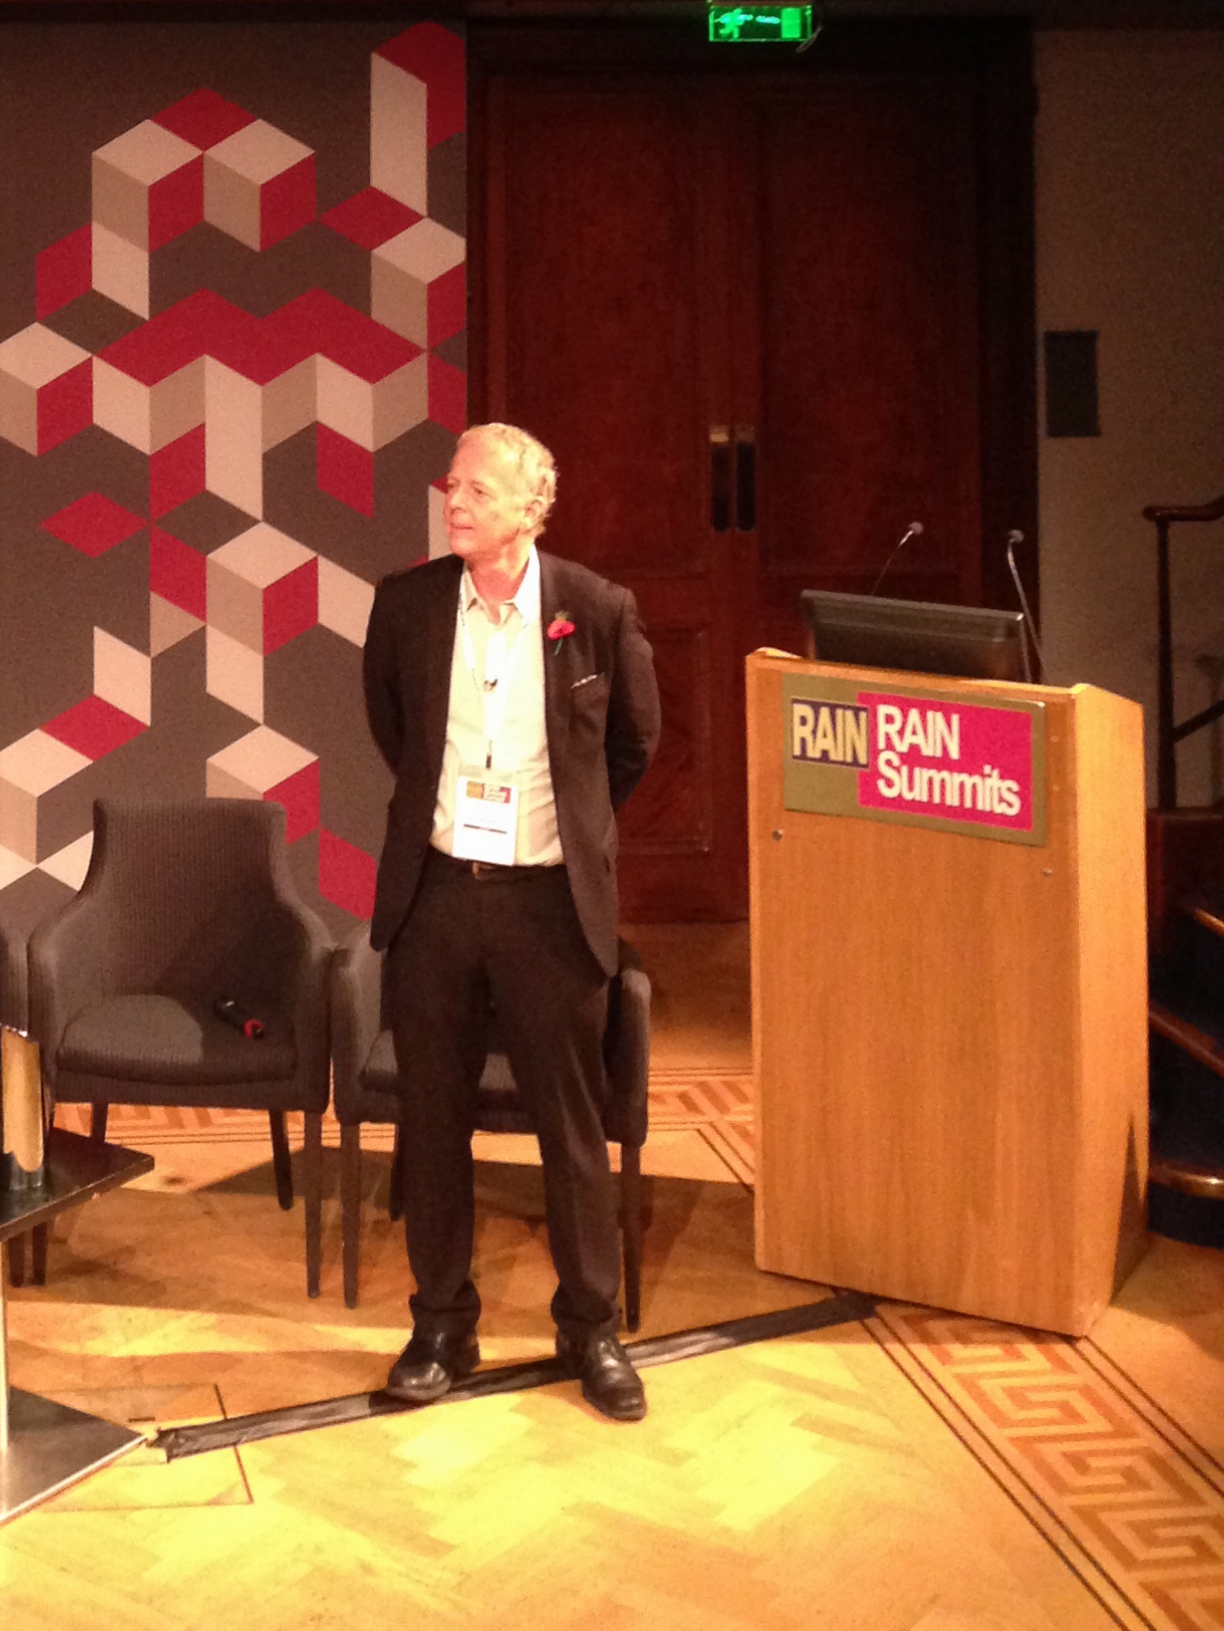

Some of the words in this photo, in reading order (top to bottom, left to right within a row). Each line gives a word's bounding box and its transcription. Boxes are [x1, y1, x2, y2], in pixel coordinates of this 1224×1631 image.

[793, 704, 867, 764] RAIN
[877, 704, 960, 760] RAIN
[877, 751, 1021, 816] Summits
